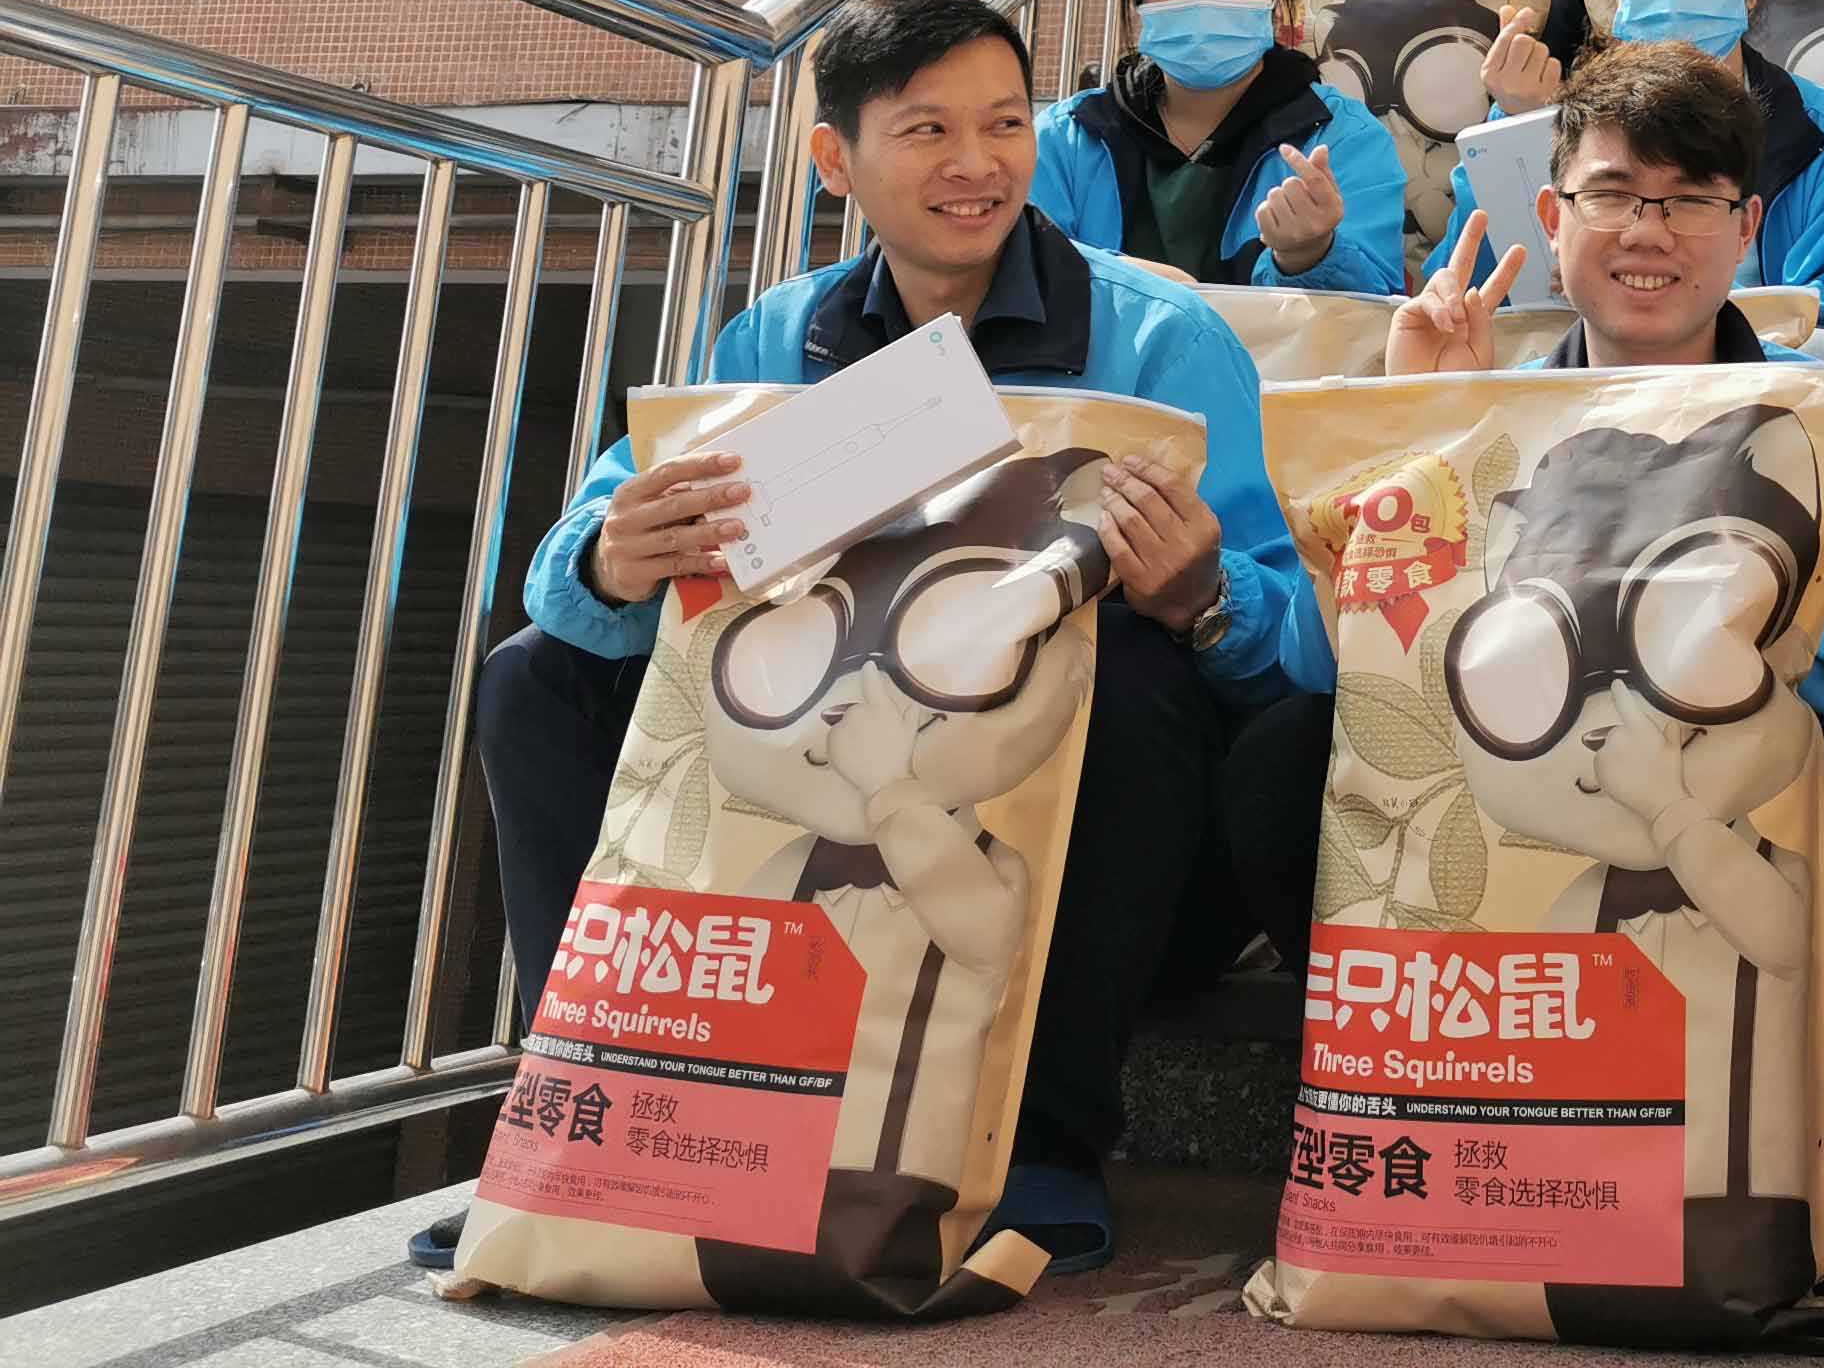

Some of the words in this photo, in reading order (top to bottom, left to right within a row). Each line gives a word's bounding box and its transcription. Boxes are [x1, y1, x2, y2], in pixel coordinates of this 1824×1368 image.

[542, 990, 587, 1025] Three
[591, 998, 712, 1043] Squirrels
[600, 1050, 658, 1069] UNDERSTAND
[659, 1059, 685, 1073] YOUR
[688, 1063, 727, 1079] TONGUE
[728, 1069, 767, 1084] BETTER
[769, 1073, 797, 1087] THAN
[1312, 1042, 1374, 1077] Three
[1383, 1049, 1535, 1089] Squirrels
[498, 1070, 613, 1147] 型零食
[629, 1089, 680, 1125] 拯救
[1406, 1102, 1478, 1118] UNDERSTAND
[1479, 1105, 1511, 1119] YOUR
[1512, 1106, 1559, 1119] TONGUE
[1560, 1106, 1605, 1120] BETTER
[1606, 1106, 1638, 1120] THAN
[1639, 1106, 1674, 1120] GF/BF
[625, 1125, 770, 1174] 零食选择恐惧
[1288, 1121, 1433, 1201] 型零食
[1453, 1138, 1509, 1171] 拯救
[1453, 1175, 1621, 1212] 零食选择恐惧
